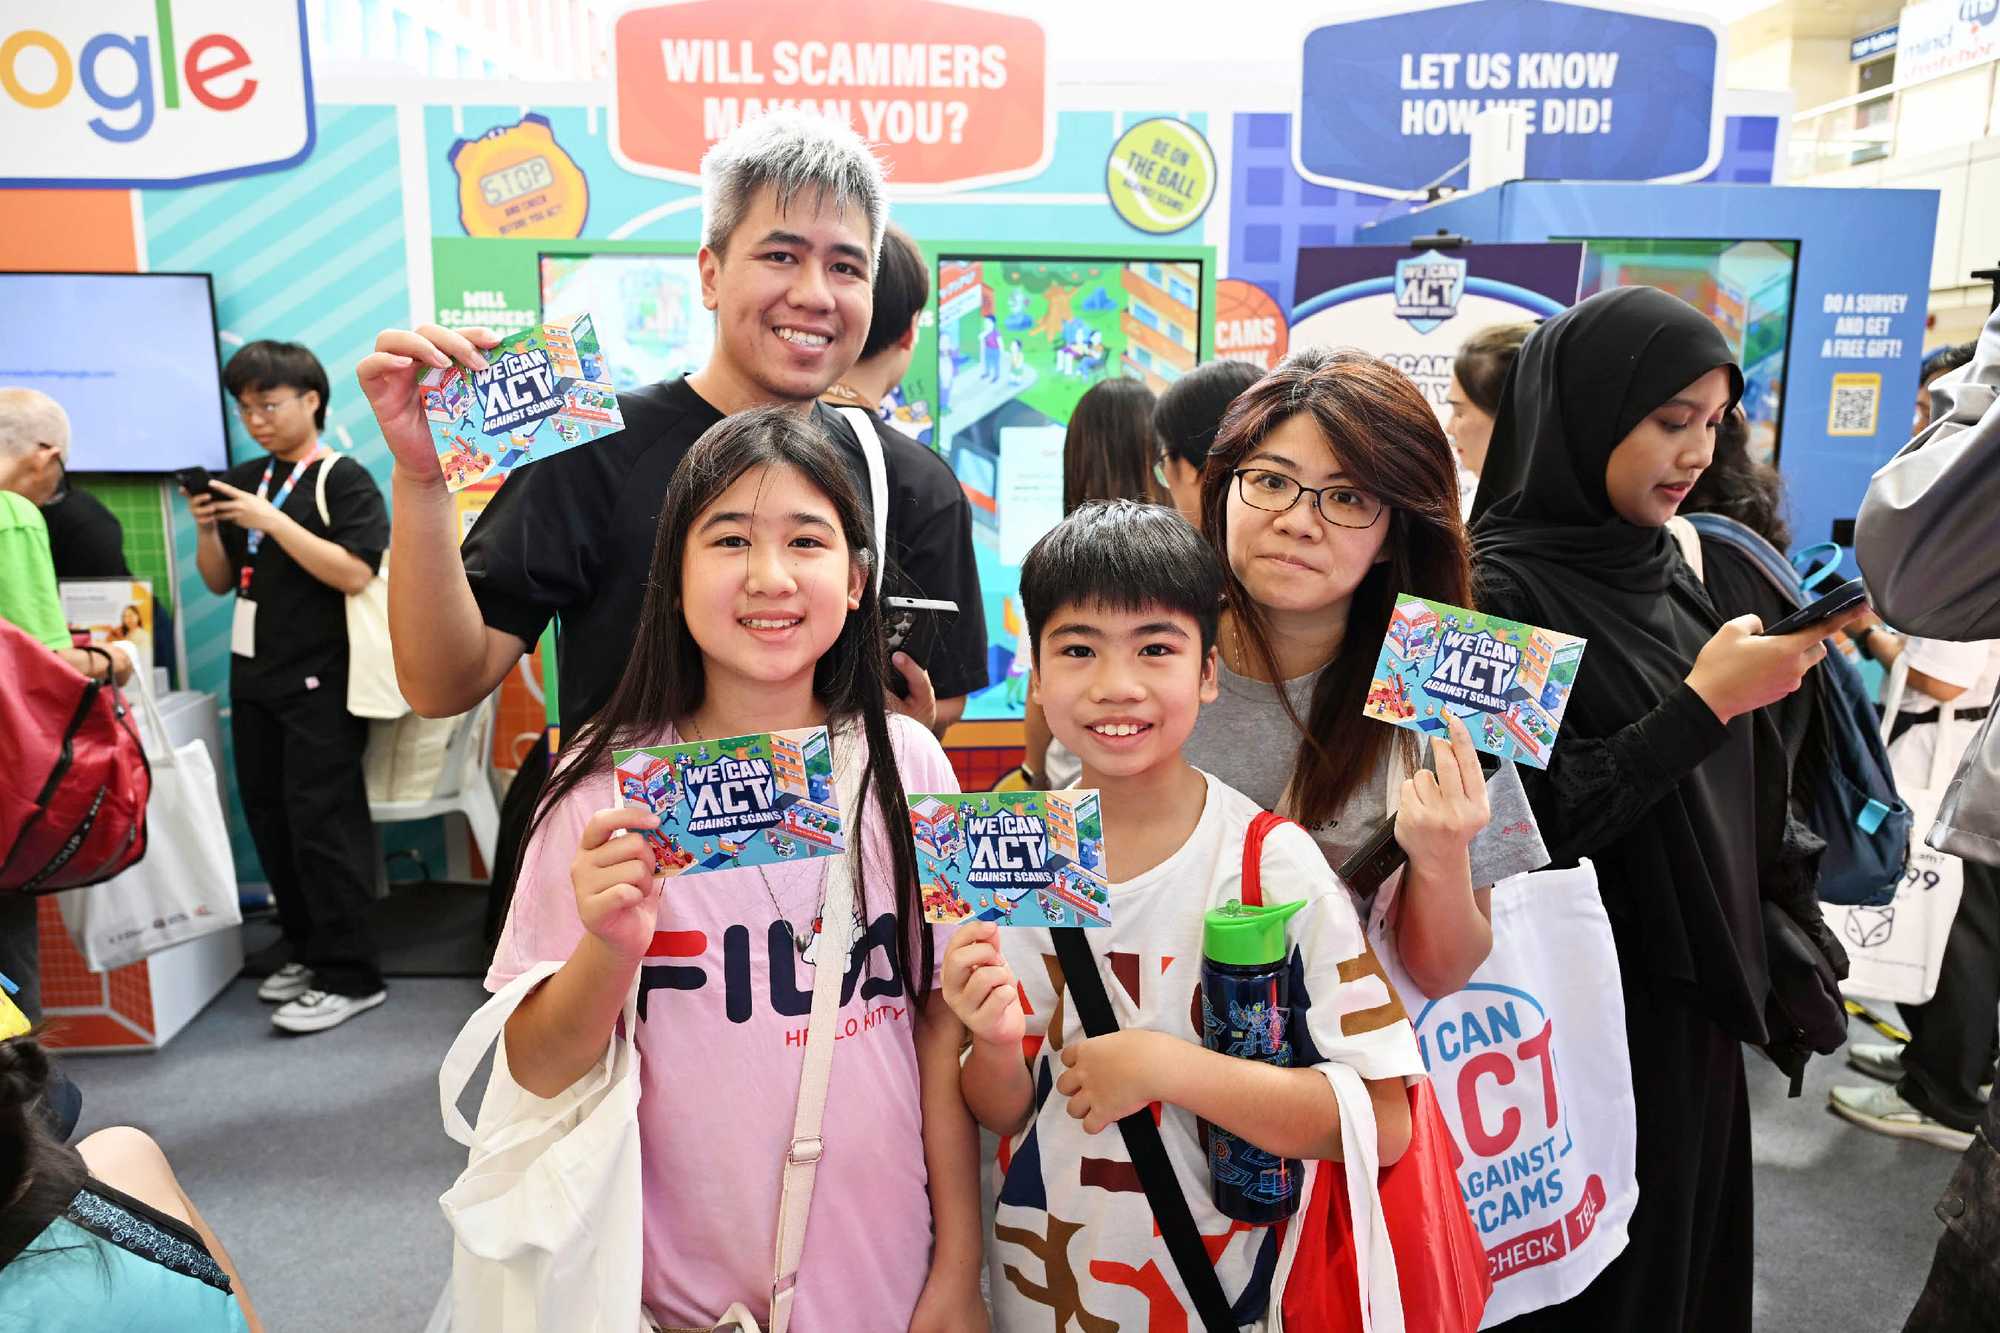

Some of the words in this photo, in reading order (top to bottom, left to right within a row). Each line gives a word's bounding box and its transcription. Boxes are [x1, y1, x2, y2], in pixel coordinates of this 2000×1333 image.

[661, 39, 764, 83] WILL
[773, 41, 1008, 89] SCAMMERS
[1400, 53, 1461, 89] LET
[1466, 53, 1512, 89] US
[1517, 52, 1619, 89] KNOW
[859, 99, 969, 144] YOU?
[1400, 99, 1479, 135] HOW
[1485, 99, 1537, 134] E
[1541, 98, 1613, 134] DID!
[1151, 138, 1170, 159] BE
[484, 161, 545, 204] STOP
[1128, 151, 1157, 180] THE
[1157, 166, 1196, 199] BALL
[1400, 279, 1454, 305] ACT
[1844, 293, 1855, 313] A
[1856, 293, 1908, 313] SURVEY
[1215, 316, 1276, 349] CAMS
[1835, 316, 1864, 336] AND
[1865, 316, 1892, 336] GET
[1821, 338, 1833, 358] A
[1833, 338, 1866, 358] FREE
[475, 362, 505, 386] WE
[508, 349, 547, 375] CAN
[485, 366, 551, 419] ACT
[483, 408, 525, 432] AGAINST
[526, 396, 563, 417] SCAMS
[1444, 630, 1477, 652] WE
[1480, 639, 1518, 664] CAN
[1431, 650, 1510, 696] ACT
[1423, 680, 1469, 699] AGAINST
[1469, 691, 1507, 710] SCAMS
[686, 765, 720, 785] WE
[726, 758, 770, 780] CAN
[692, 777, 769, 819] ACT
[688, 815, 737, 832] AGAINST
[739, 810, 782, 825] SCAMS
[968, 817, 999, 835] WE
[1004, 816, 1043, 834] CAN
[971, 836, 1041, 869] ACT
[968, 871, 1013, 882] AGAINST
[1014, 871, 1053, 882] SCAMS
[1906, 867, 1940, 891] 99
[636, 912, 903, 1024] FILA
[786, 1018, 857, 1047] HLO
[864, 1005, 906, 1031] KITTY
[1436, 1001, 1522, 1062] CAN
[1453, 1018, 1559, 1169] CT
[1468, 1168, 1564, 1234] CAMS
